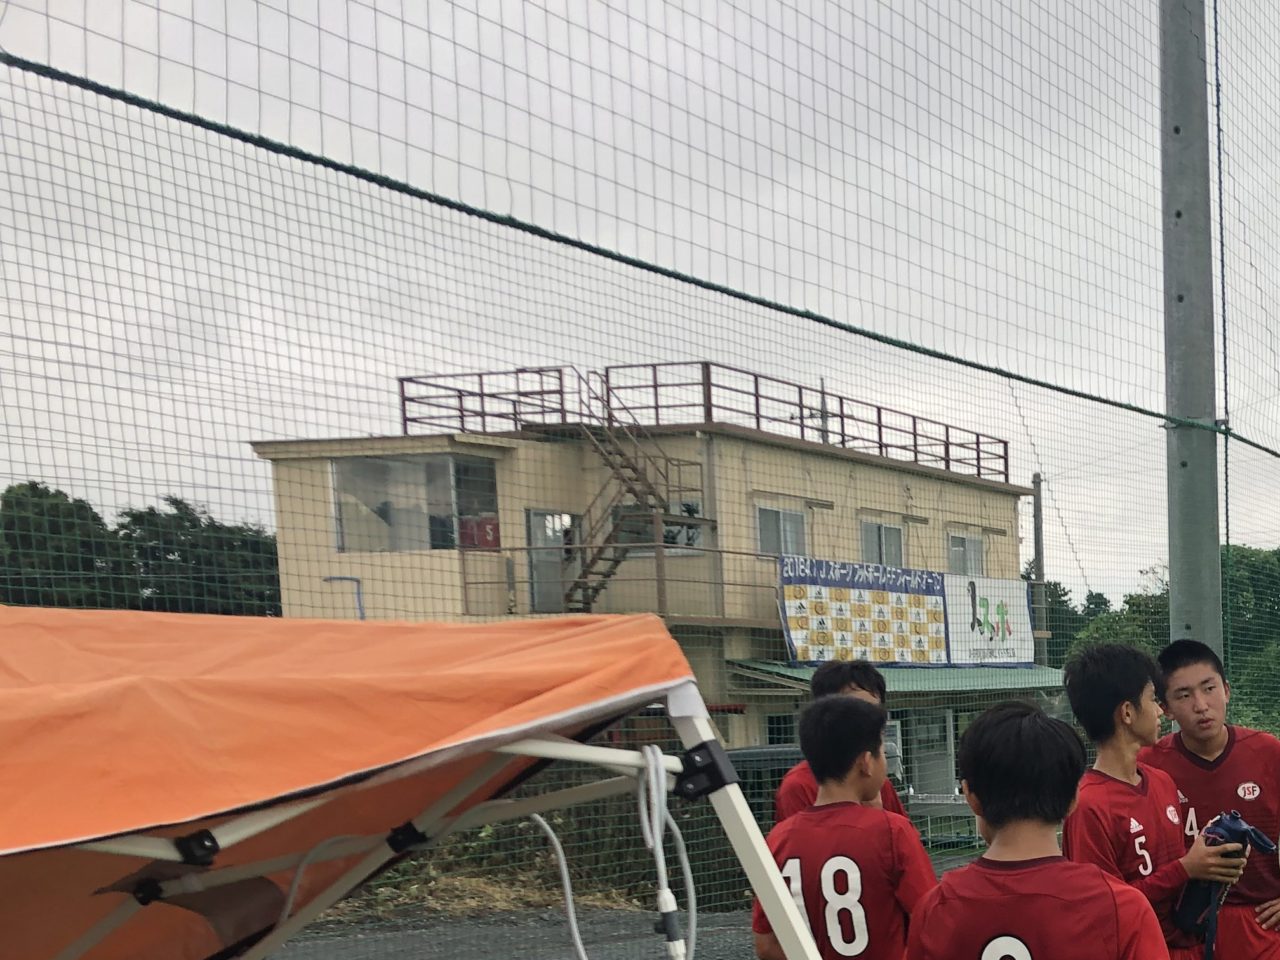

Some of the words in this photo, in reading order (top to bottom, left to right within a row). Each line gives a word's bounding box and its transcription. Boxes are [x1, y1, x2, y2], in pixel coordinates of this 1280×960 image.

[1241, 785, 1257, 796] JSF
[1185, 807, 1200, 839] 4
[1134, 835, 1153, 876] 5
[781, 855, 869, 957] 18
